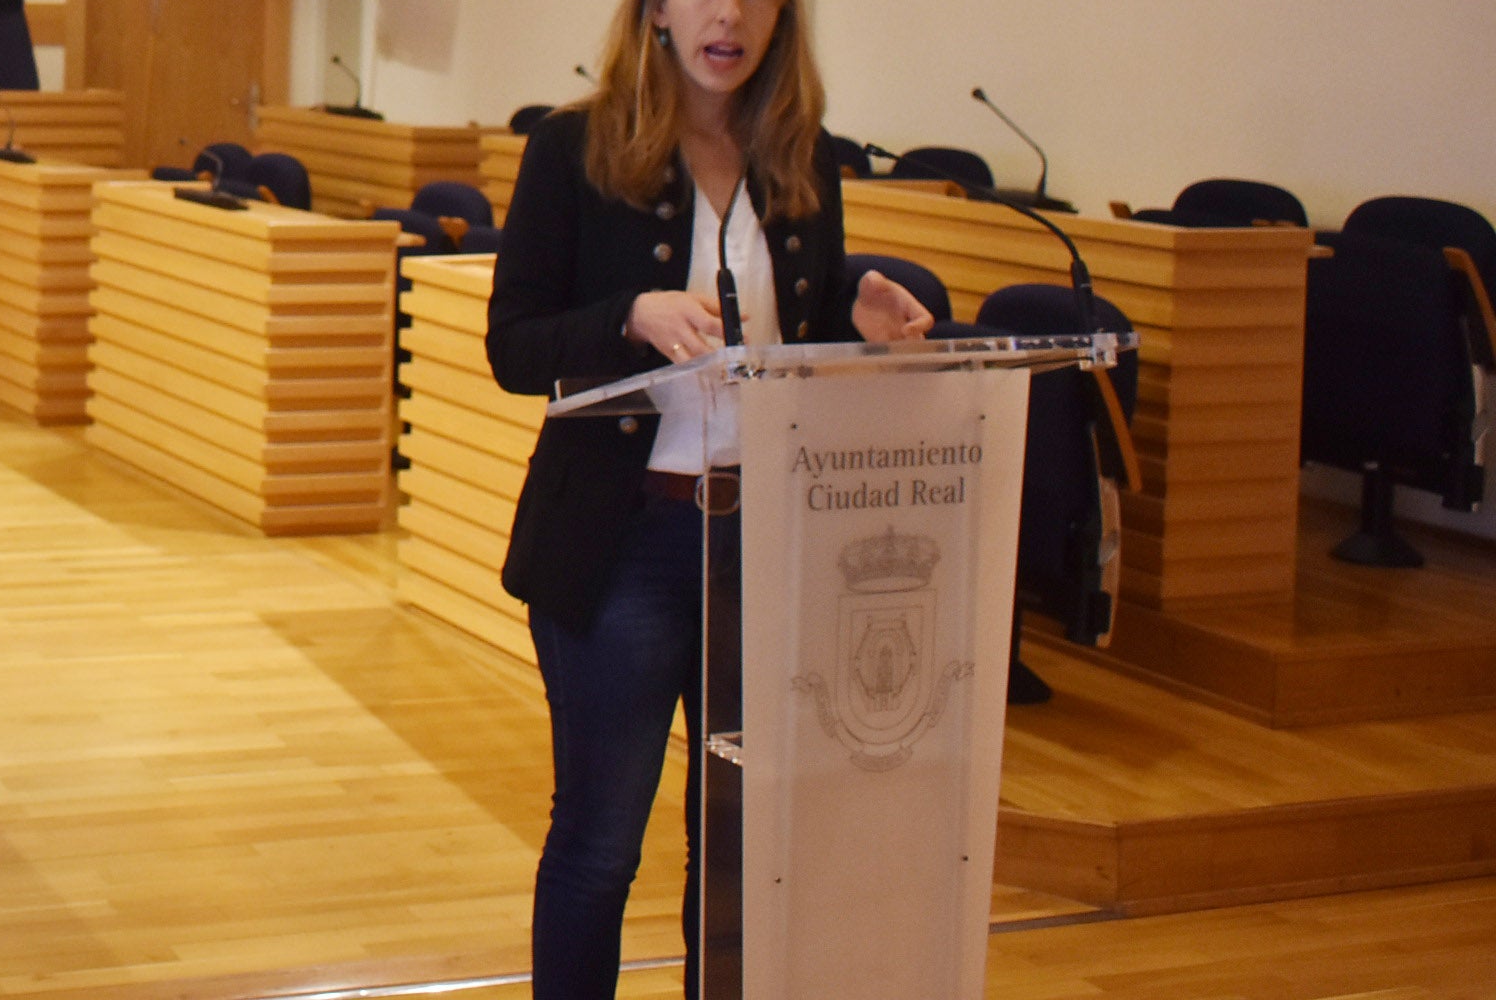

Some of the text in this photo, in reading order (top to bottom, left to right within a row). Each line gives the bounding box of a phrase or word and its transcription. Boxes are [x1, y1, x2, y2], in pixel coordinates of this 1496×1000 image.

[791, 441, 983, 479] Ayuntamiento
[807, 476, 966, 511] Ciudad Real
